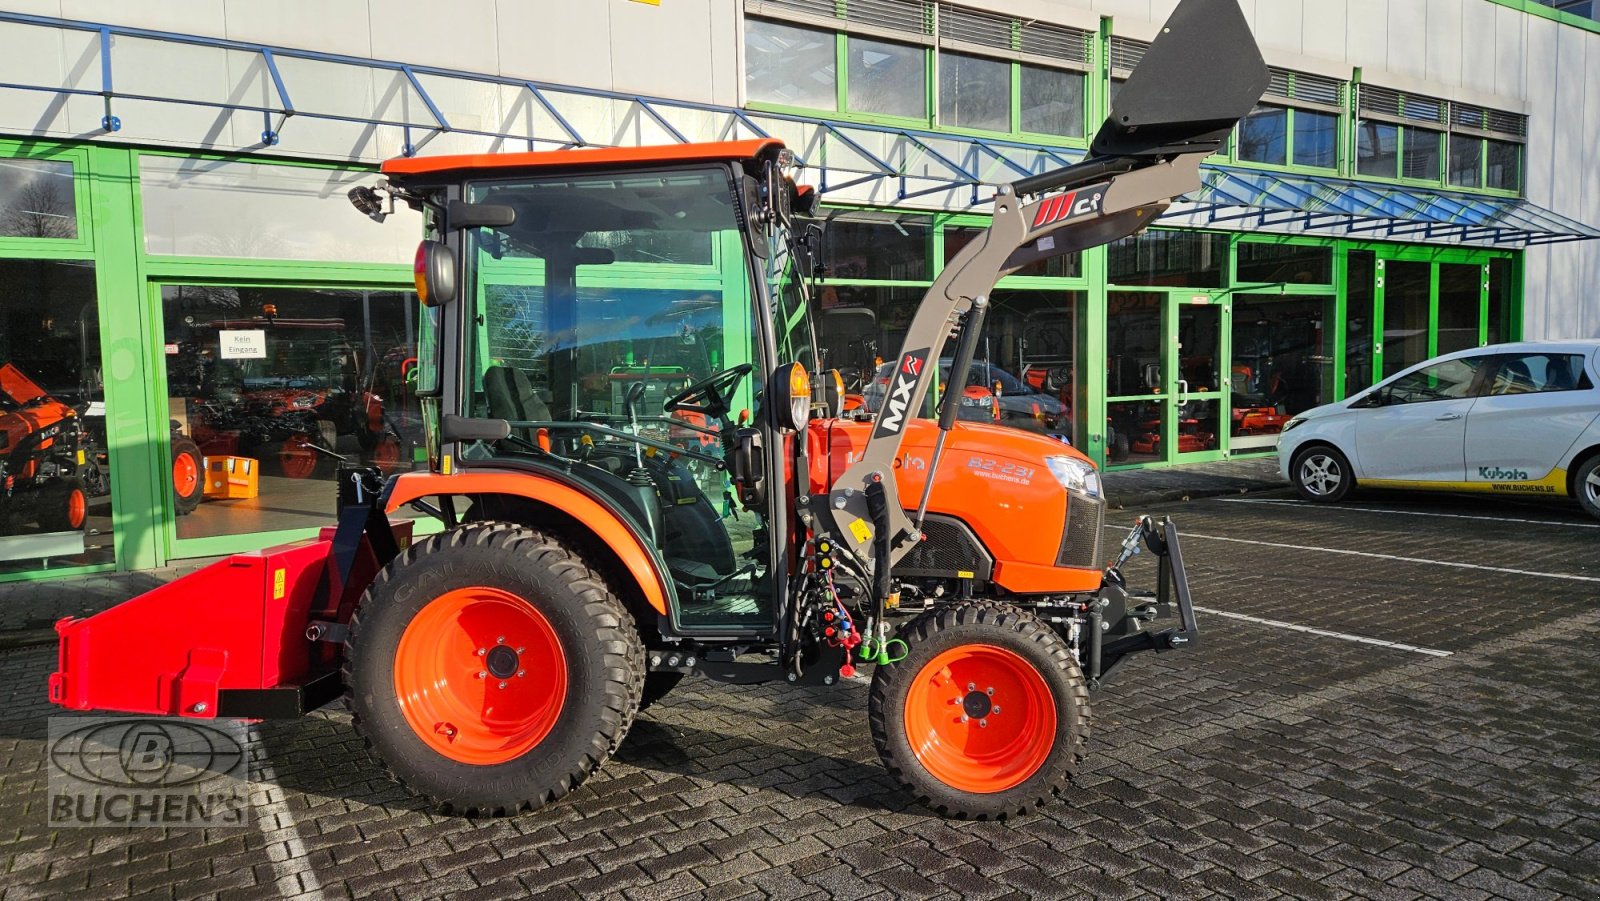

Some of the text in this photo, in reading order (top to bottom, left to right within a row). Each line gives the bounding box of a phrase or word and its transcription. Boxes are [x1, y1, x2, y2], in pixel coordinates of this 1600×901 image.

[234, 335, 251, 343] Kein
[228, 346, 258, 354] Eingang
[882, 374, 916, 432] MX
[973, 469, 1030, 486] www.buchens.de
[1479, 466, 1528, 480] Kubota
[1491, 483, 1556, 493] WWW.BUCHENS.DE
